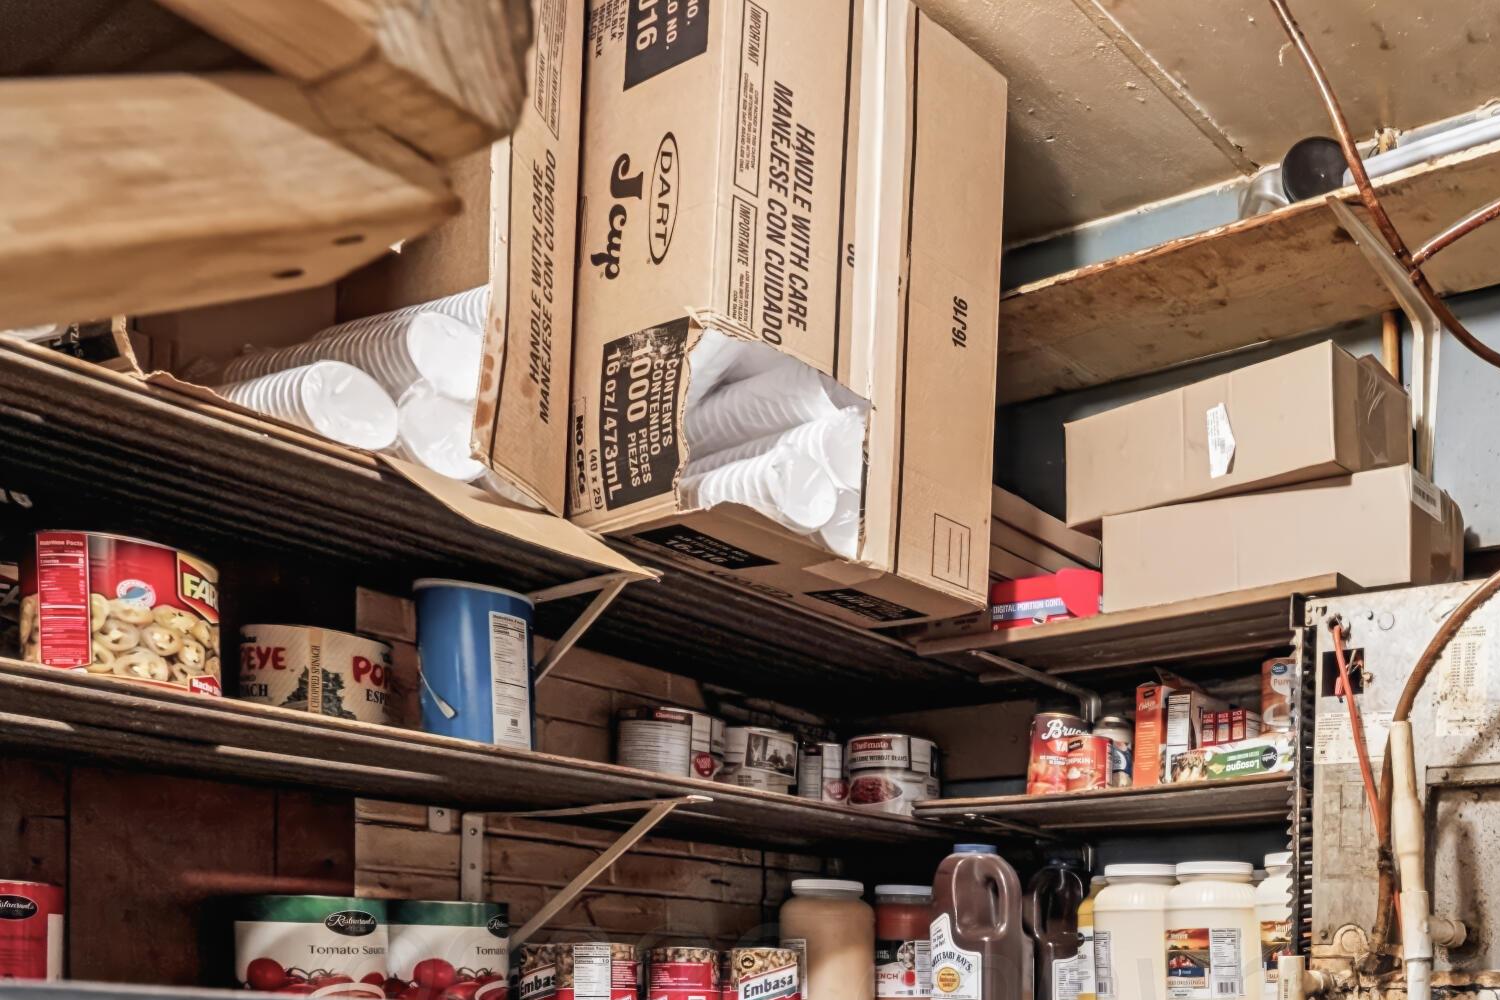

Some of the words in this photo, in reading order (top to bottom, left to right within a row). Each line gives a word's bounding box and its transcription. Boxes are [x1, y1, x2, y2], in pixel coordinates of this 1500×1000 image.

[747, 6, 763, 67] IMPORTANT
[531, 159, 544, 225] CARE
[792, 123, 816, 212] HANDLE
[543, 149, 556, 250] CUIDADO
[654, 147, 675, 259] DART
[764, 199, 787, 251] CON
[530, 226, 543, 289] WITH
[736, 204, 751, 267] IMPORTANTE
[790, 215, 812, 271] WITH
[542, 252, 554, 304] CON
[761, 248, 786, 346] CUIDADO
[786, 273, 809, 332] CARE
[529, 289, 542, 385] HANDLE
[951, 295, 969, 349] 16J16
[626, 341, 653, 422] 1000
[648, 358, 666, 456] CONTENIDO
[661, 358, 680, 448] CONTENTS
[575, 415, 585, 443] NO
[638, 428, 652, 484] PIECES
[576, 449, 587, 494] CFCs
[626, 432, 641, 488] PIEZAS
[993, 604, 1017, 614] DIGITAL
[1018, 600, 1044, 612] PORTION
[310, 645, 322, 673] SPINACH
[1225, 759, 1260, 772] Lasagna
[308, 944, 359, 956] Tomato
[942, 951, 956, 960] BABY
[743, 974, 795, 1000] Embasa
